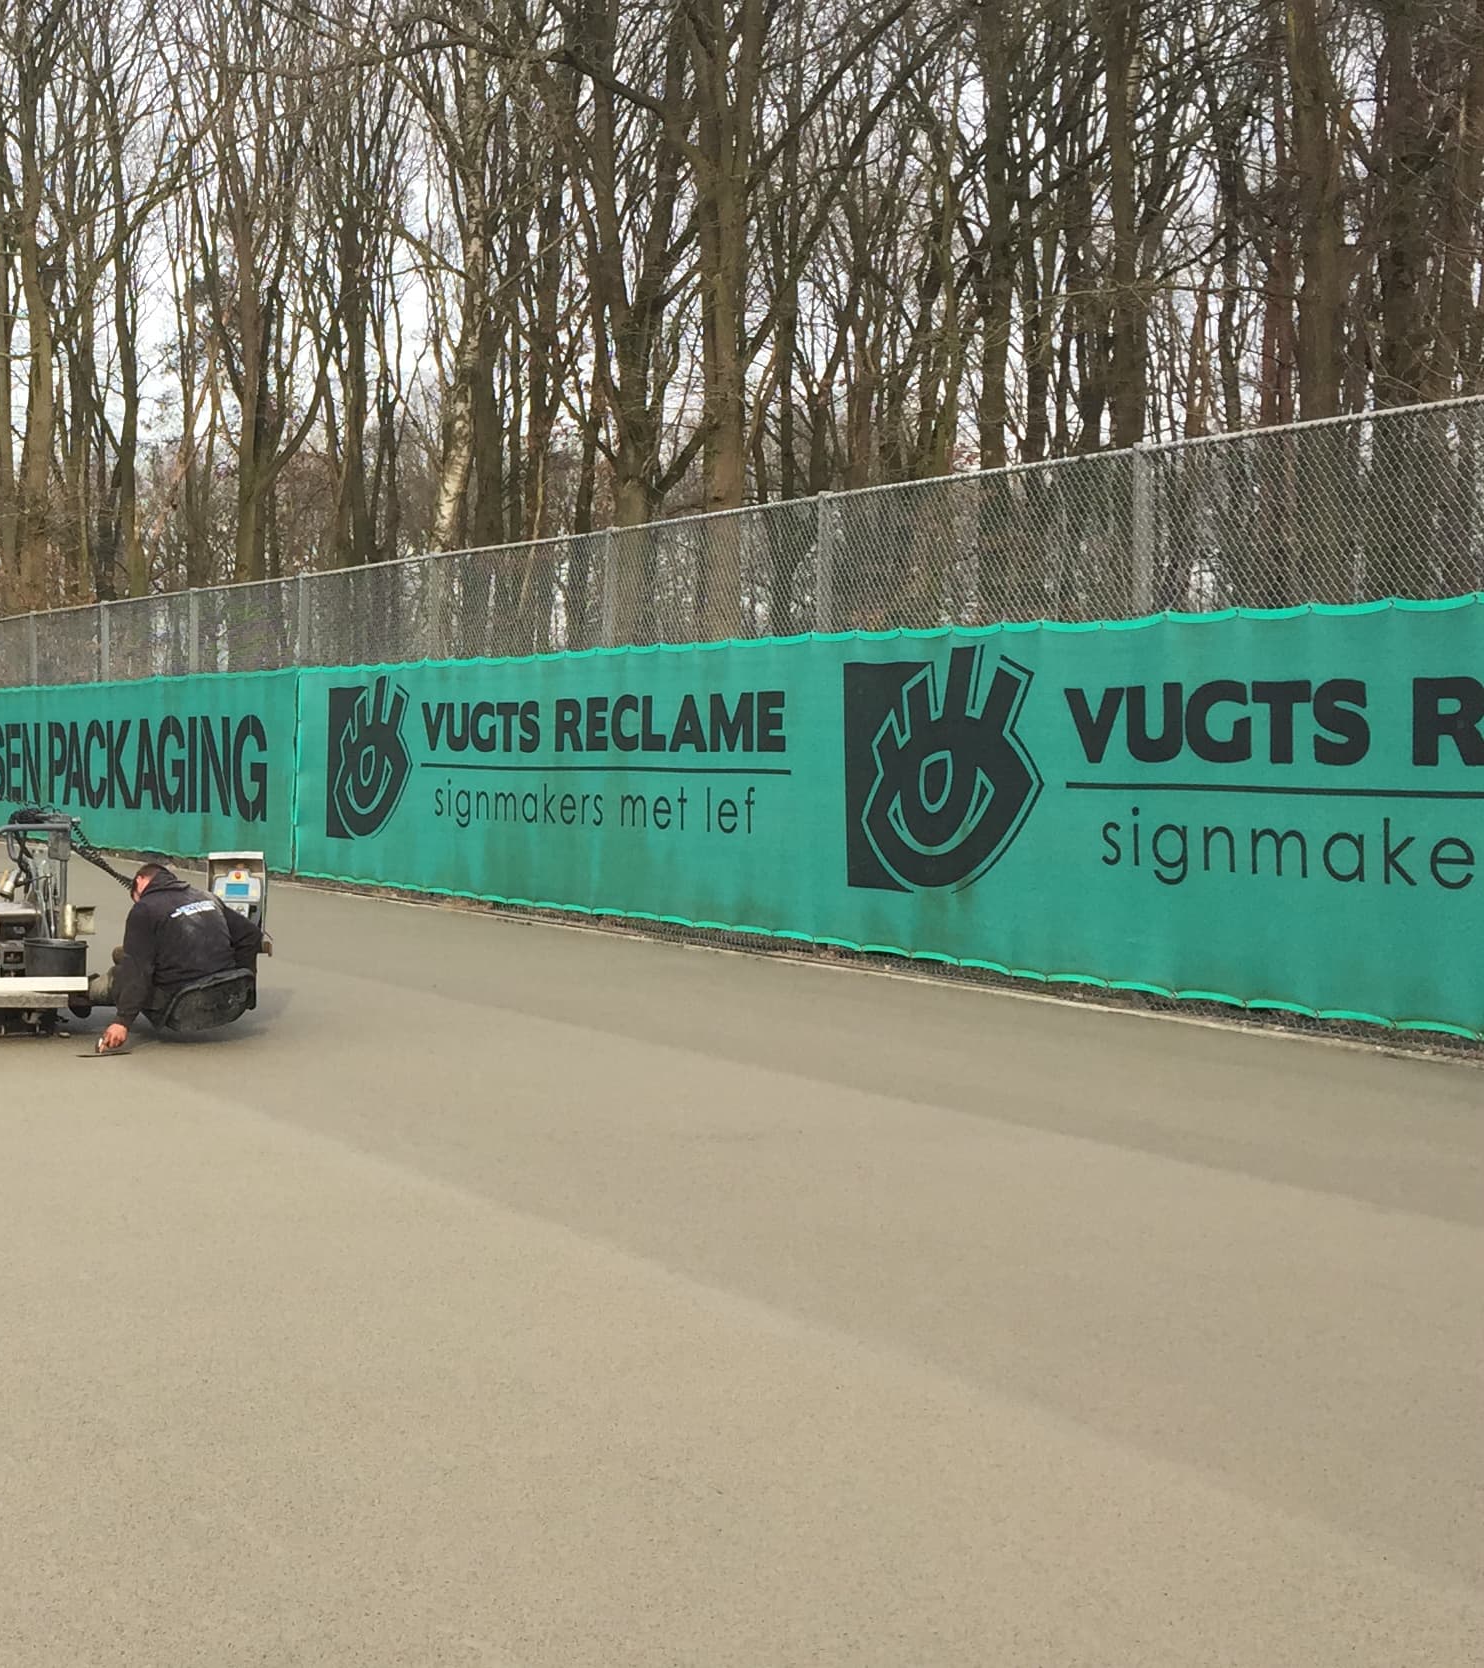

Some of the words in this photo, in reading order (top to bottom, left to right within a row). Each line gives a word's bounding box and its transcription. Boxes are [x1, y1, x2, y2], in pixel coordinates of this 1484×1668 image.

[422, 701, 541, 753] VUGTS
[554, 690, 787, 753] RECLAME
[1064, 678, 1371, 766] VUGTS
[48, 714, 268, 822] PACKAGING
[434, 778, 604, 829] signmakers
[620, 786, 688, 831] met
[706, 786, 756, 834] lef
[1101, 806, 1476, 890] signmake
